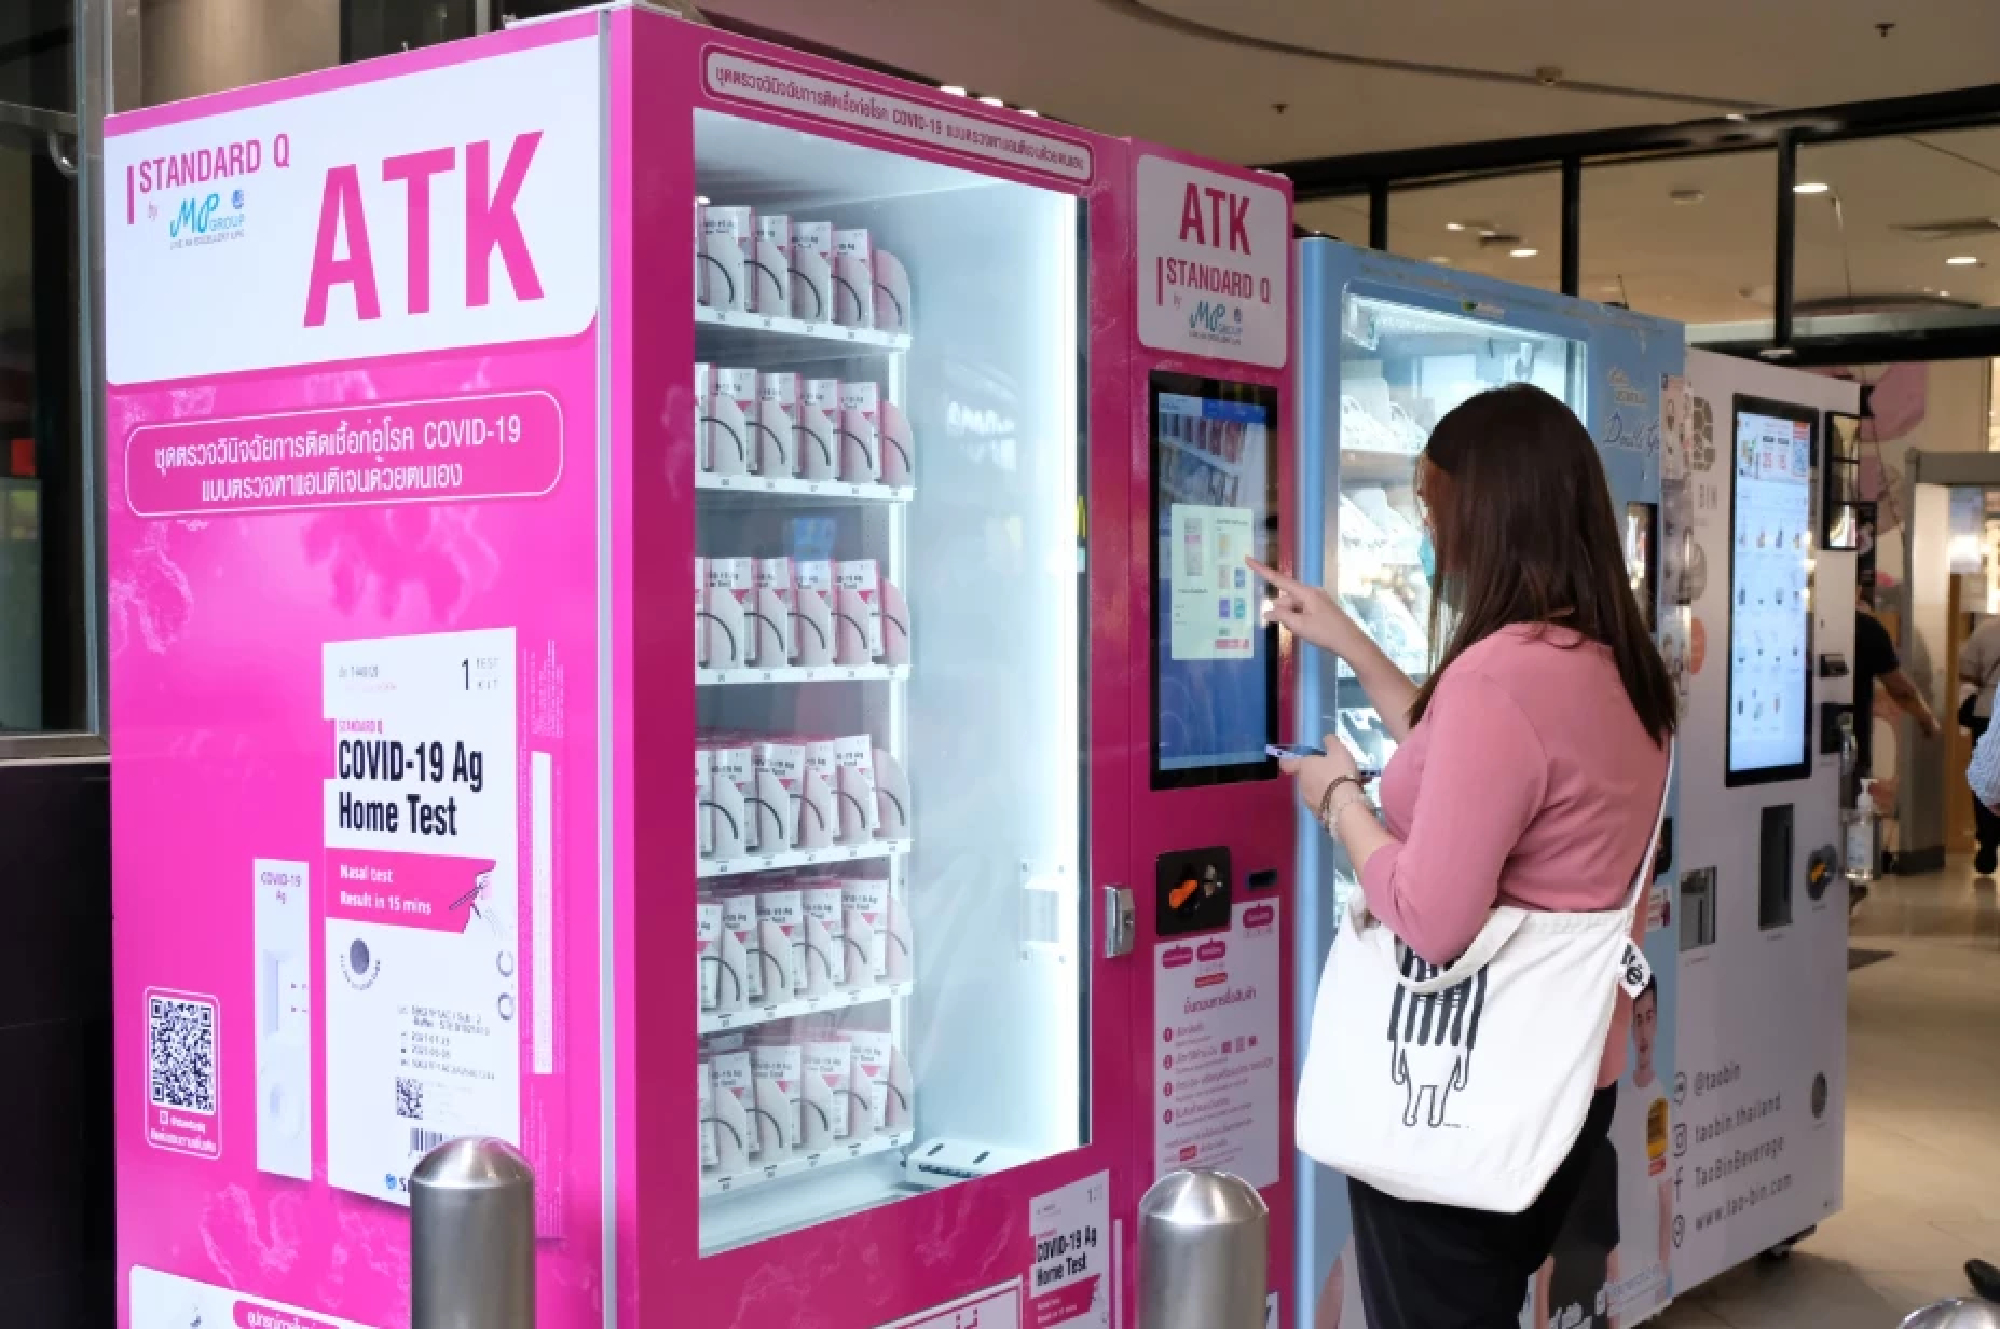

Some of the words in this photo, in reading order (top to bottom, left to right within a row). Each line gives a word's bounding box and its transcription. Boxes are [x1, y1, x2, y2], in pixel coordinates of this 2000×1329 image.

[892, 109, 943, 135] COVID-19
[139, 139, 261, 194] STANDARD
[274, 133, 290, 169] Q
[303, 129, 544, 328] ATK
[1179, 182, 1251, 257] ATK
[1166, 257, 1254, 300] STANDARD
[424, 414, 521, 450] COVID-19
[461, 657, 469, 691] 1
[338, 739, 444, 783] COVID-19
[452, 739, 484, 793] Ag
[338, 791, 399, 833] Home
[406, 793, 458, 836] Test
[260, 871, 302, 888] COVID-19
[340, 864, 369, 881] Nasal
[370, 867, 393, 883] test
[340, 890, 373, 908] Result
[374, 893, 385, 909] in
[388, 895, 400, 912] 15
[402, 898, 432, 916] mins
[1694, 1060, 1740, 1097] @taobin
[1694, 1136, 1785, 1188] TaoBinBeverage
[1695, 1173, 1793, 1232] www.tao-bin.com
[1037, 1229, 1082, 1263] COVID-19
[1084, 1224, 1097, 1248] Ag
[1037, 1263, 1065, 1287] Home
[1066, 1251, 1088, 1276] Test
